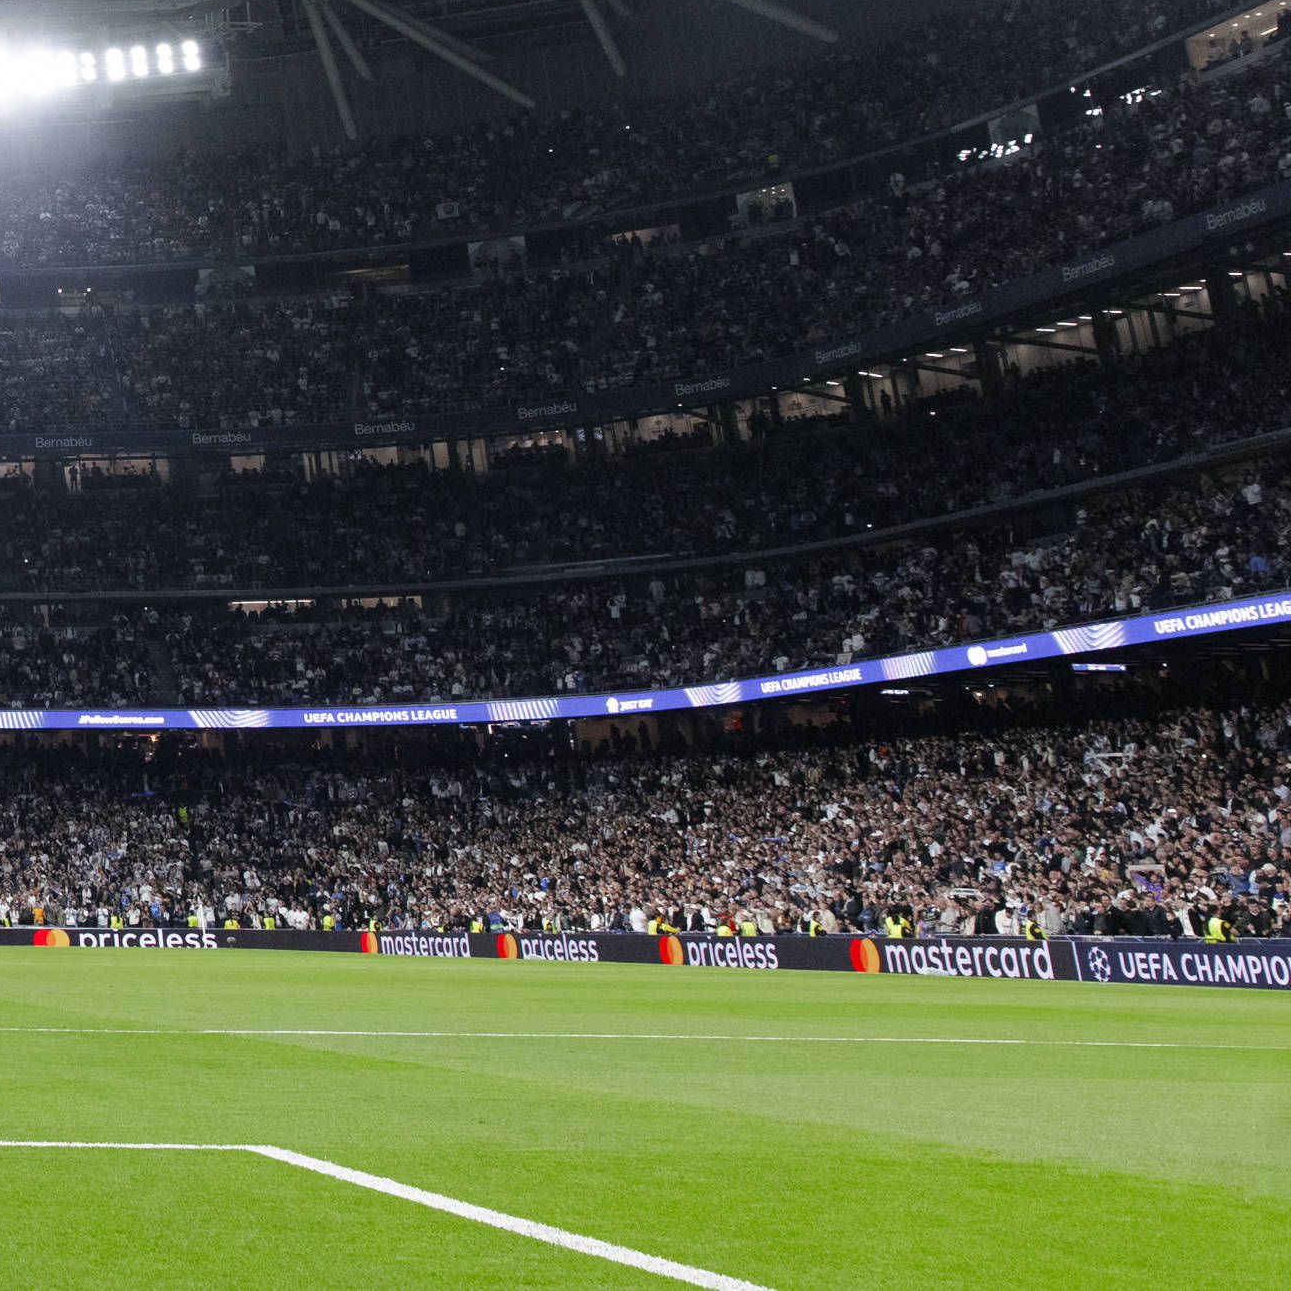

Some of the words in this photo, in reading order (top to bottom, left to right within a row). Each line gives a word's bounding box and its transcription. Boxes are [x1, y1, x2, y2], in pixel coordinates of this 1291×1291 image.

[1205, 199, 1267, 231] Bernabéu
[1061, 253, 1116, 283] Bernabéu
[935, 301, 983, 327] Bernabéu
[814, 341, 862, 366] Bernabéu
[674, 375, 730, 397] Bernabéu
[518, 401, 577, 420] Bernabéu
[192, 430, 252, 446] Bernabéu
[354, 420, 416, 438] Bernabéu
[35, 435, 92, 450] Bernabéu
[1153, 618, 1186, 634] UEFA
[1186, 605, 1259, 630] CHAMPIONS
[760, 680, 781, 694] UEFA
[781, 674, 830, 692] CHAMPIONS
[828, 669, 862, 684] LEAGUE
[304, 711, 335, 724] UEFA
[336, 710, 410, 723] CHAMPIONS
[410, 708, 457, 720] LEAGUE
[79, 928, 218, 949] priceless
[380, 932, 471, 959] mastercard
[521, 933, 598, 963] priceless
[687, 936, 779, 970] priceless
[884, 939, 1055, 980] mastercard
[1118, 952, 1179, 981] UEFA
[1180, 953, 1291, 986] CHAMPIO
